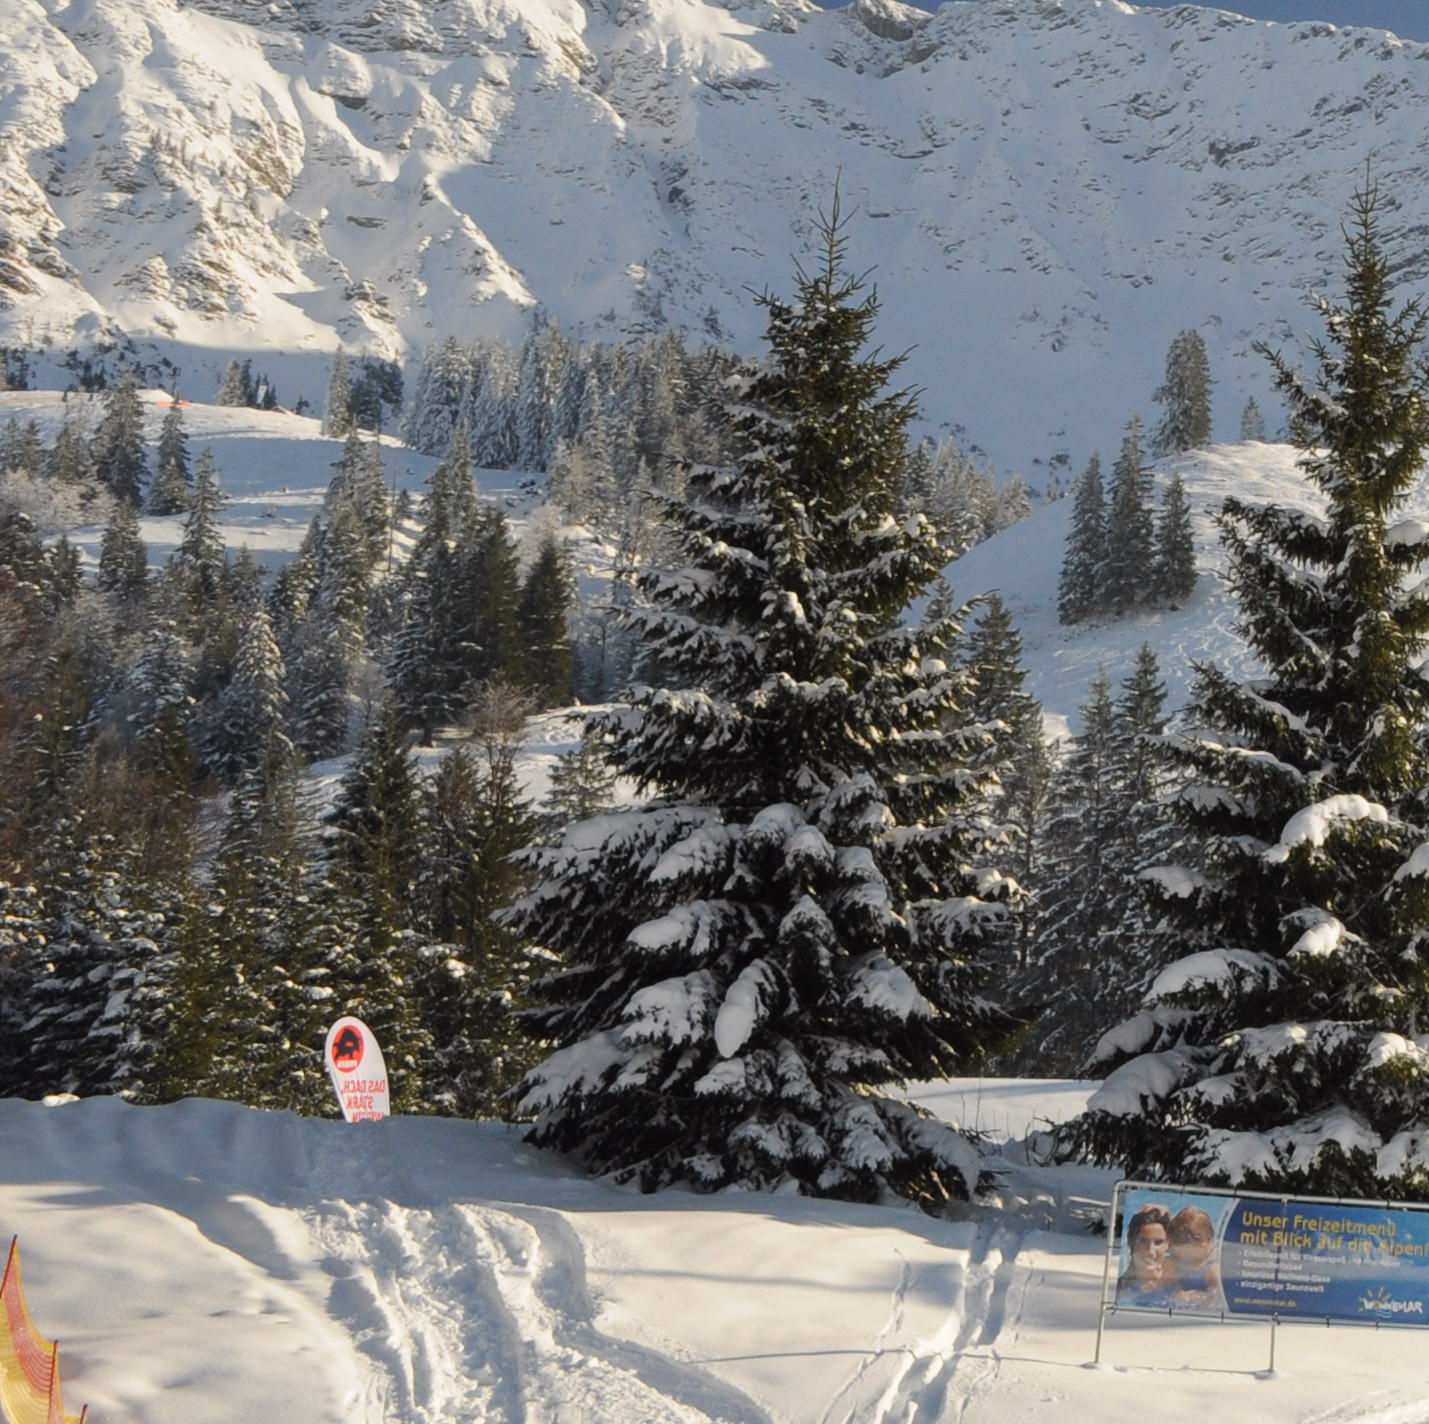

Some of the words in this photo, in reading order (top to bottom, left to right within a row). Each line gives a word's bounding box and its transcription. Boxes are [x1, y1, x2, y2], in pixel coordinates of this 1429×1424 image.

[1242, 1211, 1289, 1229] Unser
[1293, 1214, 1397, 1237] Freizeitmenü
[1240, 1230, 1268, 1245] mit
[1273, 1231, 1312, 1248] Blick
[1317, 1236, 1344, 1250] auf
[1348, 1237, 1374, 1253] die
[1379, 1239, 1429, 1257] Alpen!
